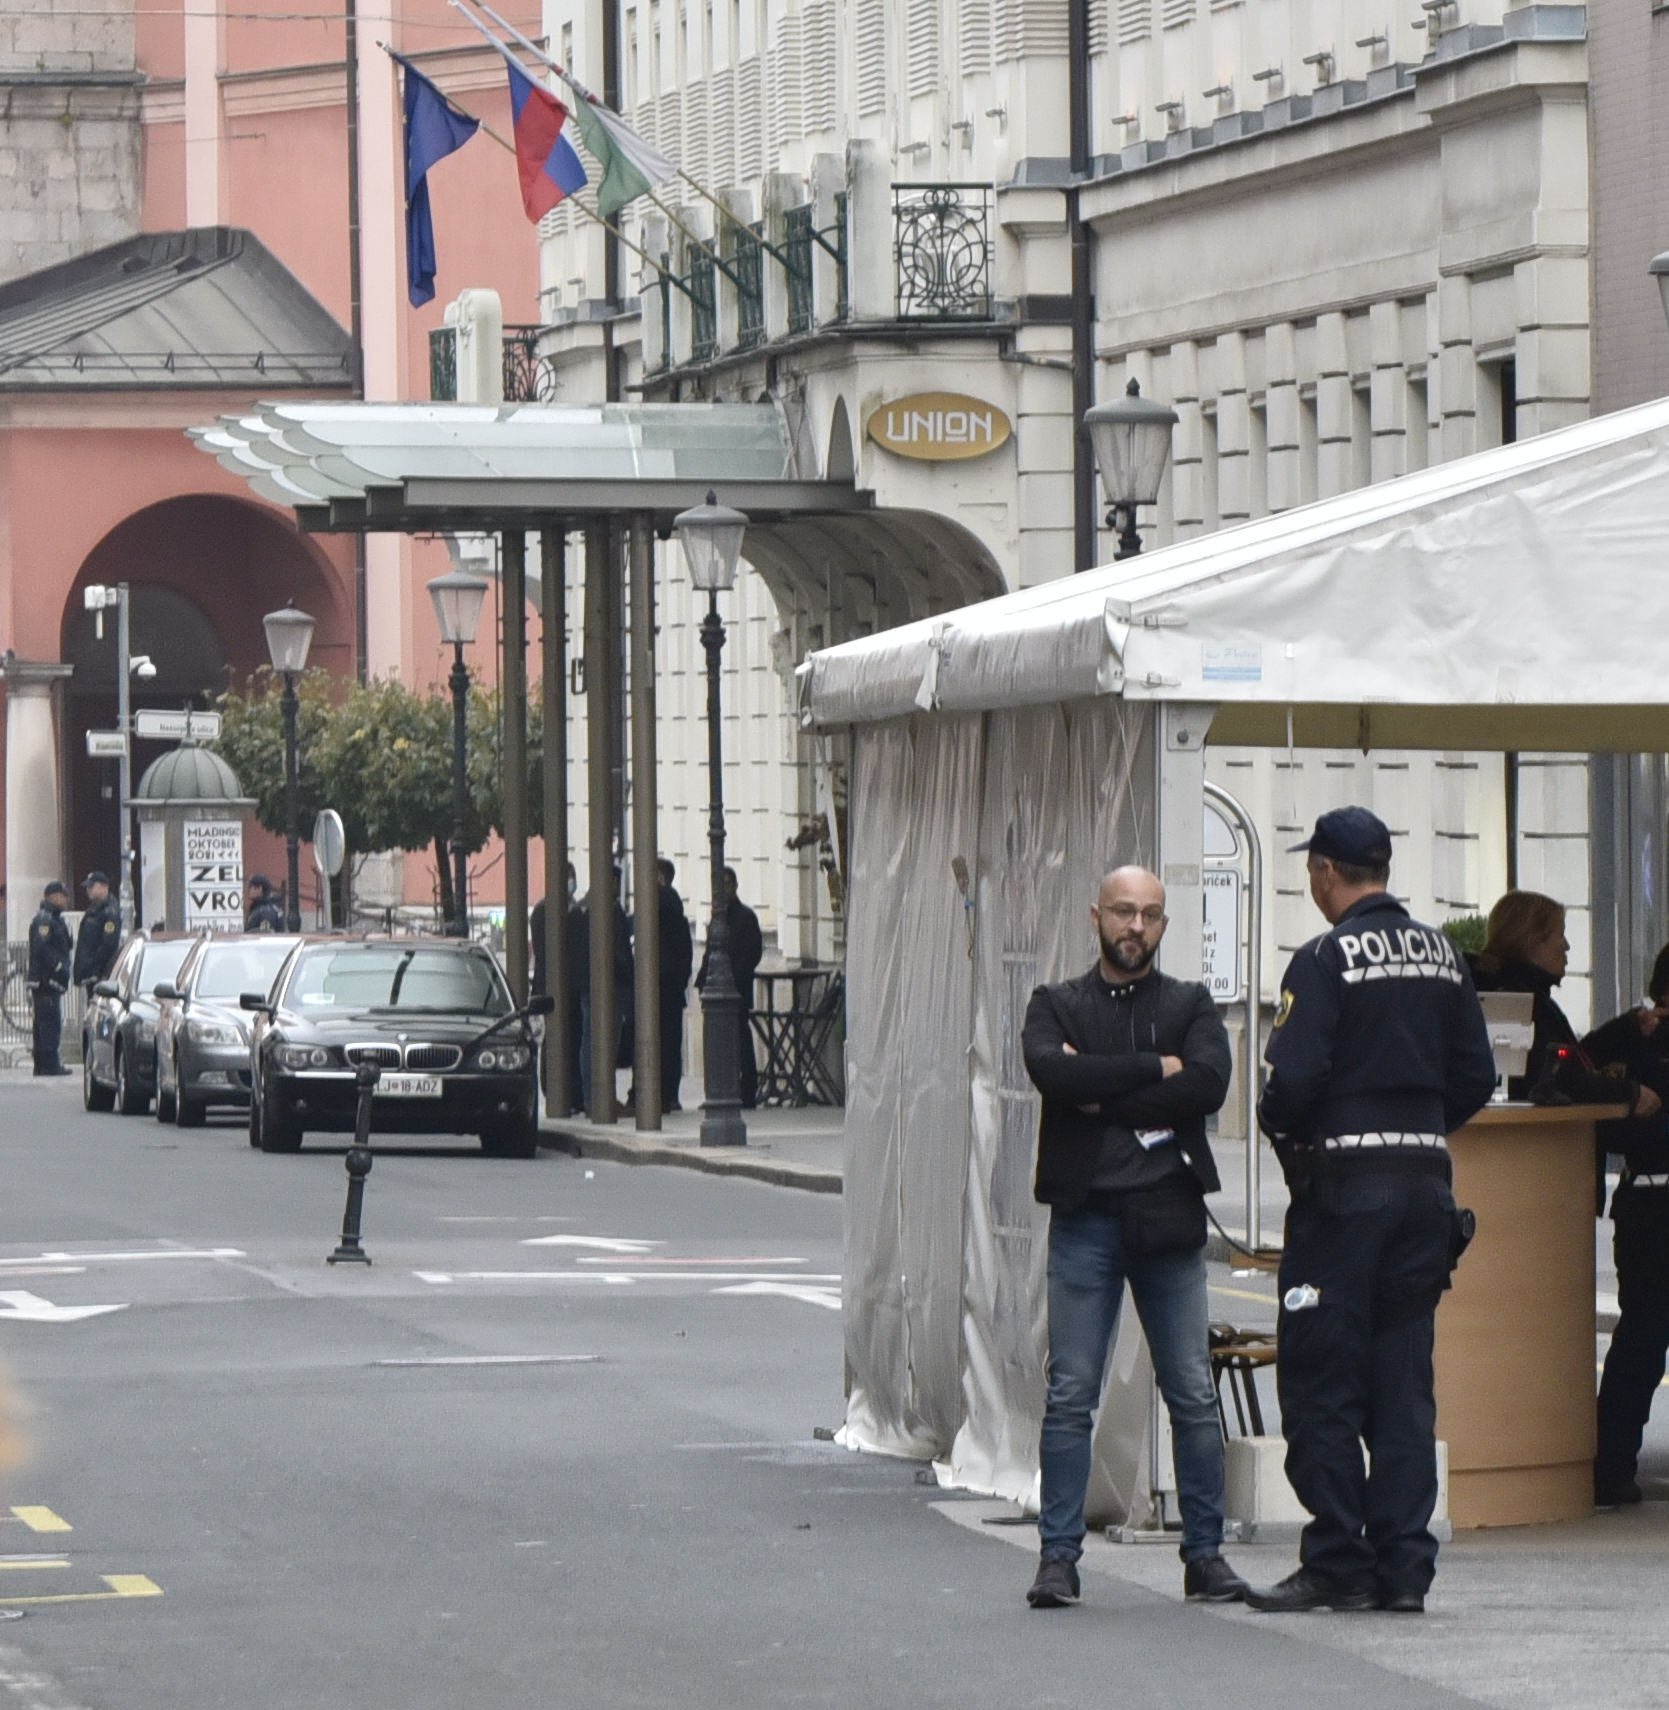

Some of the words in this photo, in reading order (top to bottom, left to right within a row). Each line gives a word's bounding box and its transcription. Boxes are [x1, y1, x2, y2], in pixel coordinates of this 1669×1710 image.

[886, 411, 992, 442] UNION
[187, 839, 236, 850] OKTOBER
[188, 849, 215, 860] 2021
[1338, 928, 1458, 970] POLICIJA
